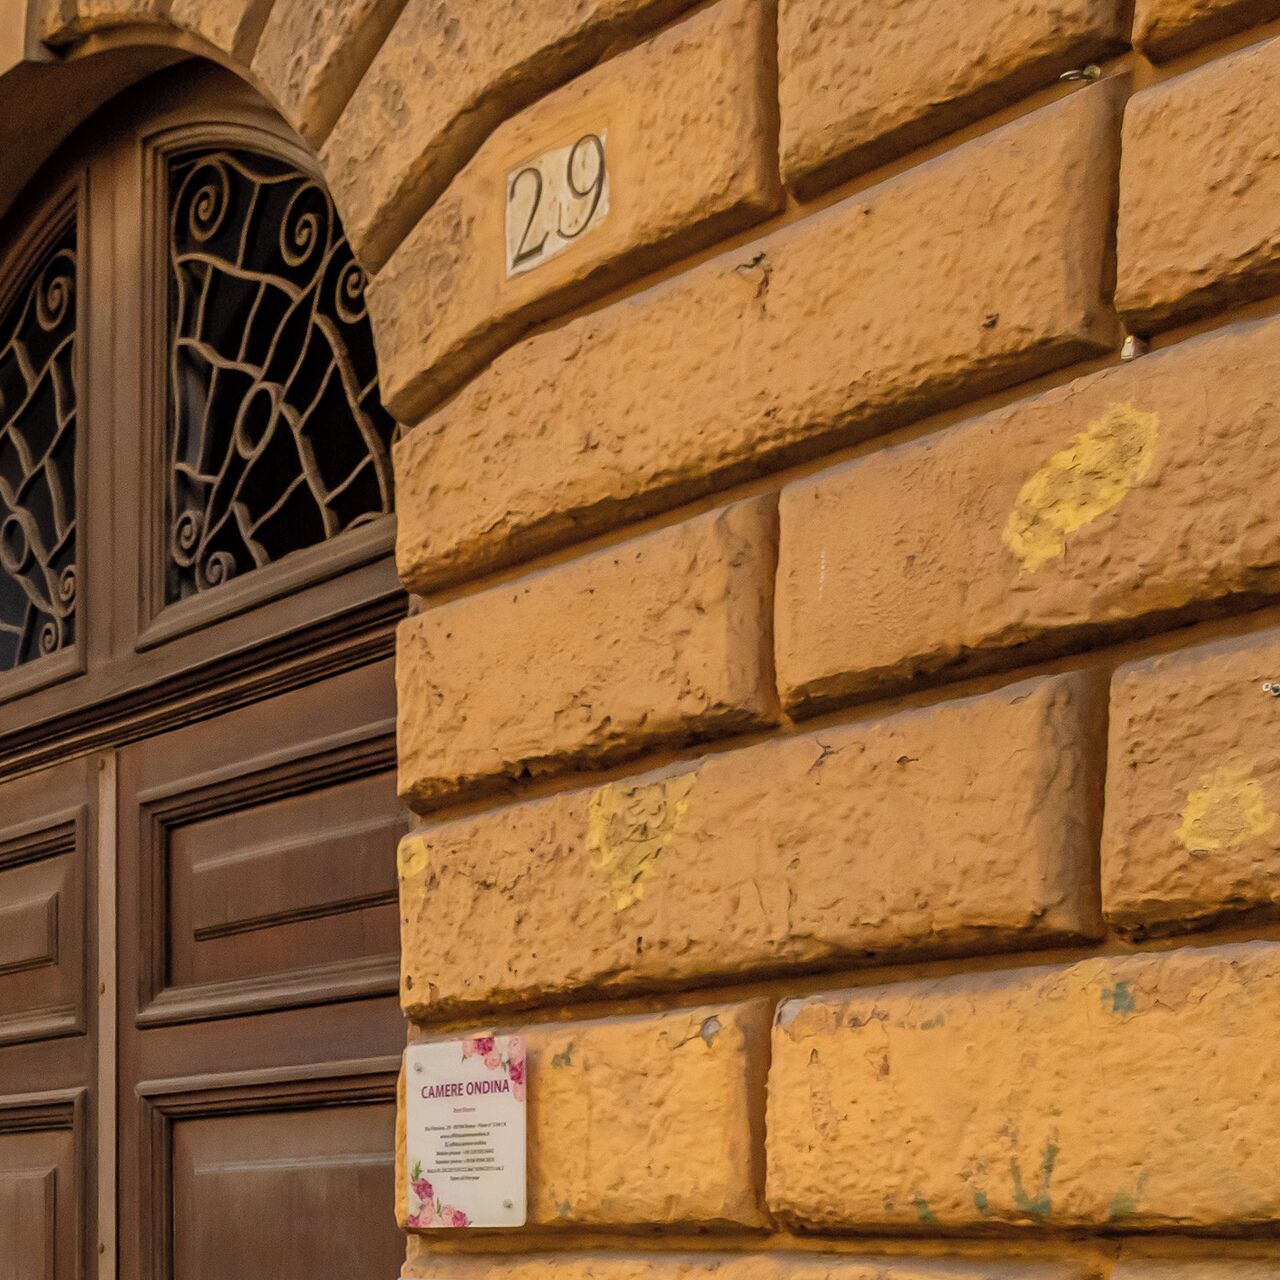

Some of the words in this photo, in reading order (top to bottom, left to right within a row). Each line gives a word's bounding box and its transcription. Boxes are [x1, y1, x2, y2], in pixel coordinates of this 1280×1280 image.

[509, 133, 605, 269] 29
[421, 1082, 464, 1099] CAMERE
[466, 1079, 510, 1096] ONDINA
